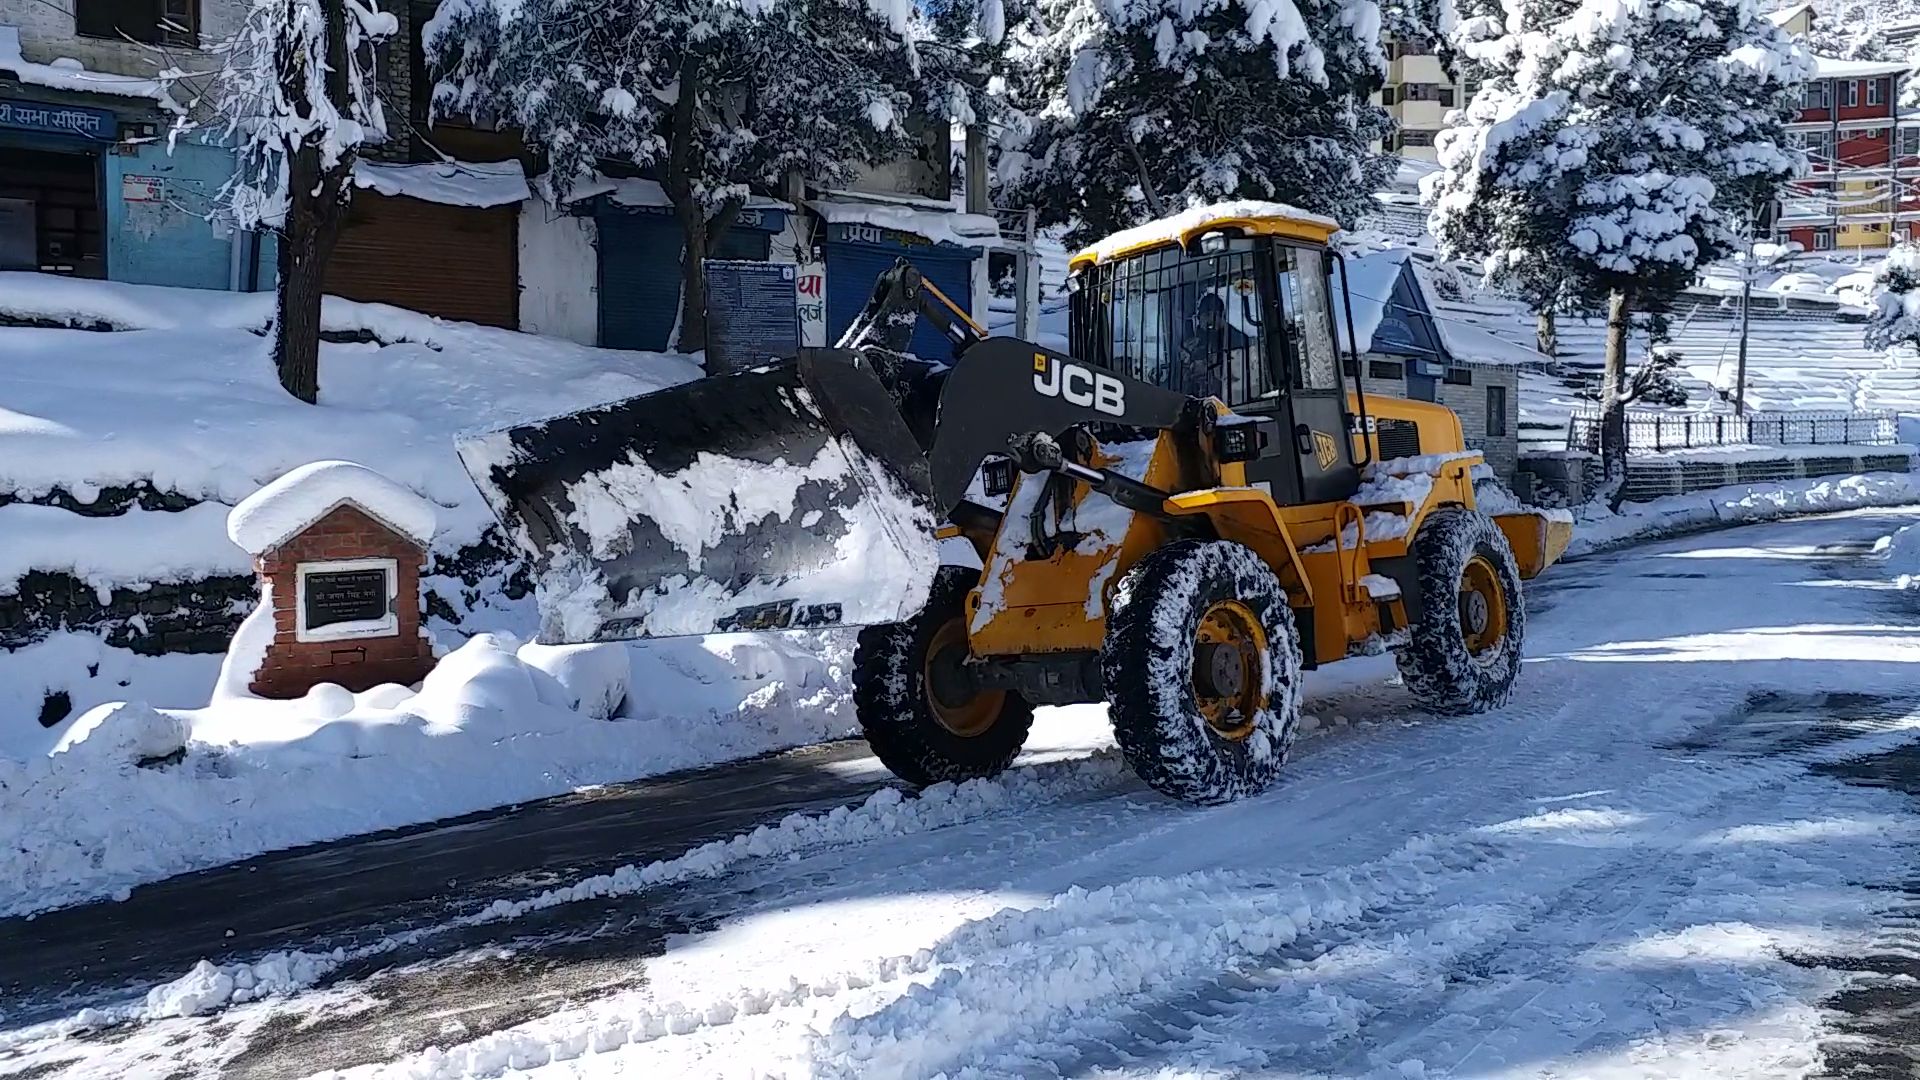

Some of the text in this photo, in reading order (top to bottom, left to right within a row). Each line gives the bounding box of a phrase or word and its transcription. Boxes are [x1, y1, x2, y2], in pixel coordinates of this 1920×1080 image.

[15, 107, 49, 126] सभा
[51, 110, 101, 131] सीमित
[1033, 358, 1125, 417] JCB
[1351, 415, 1377, 434] CB
